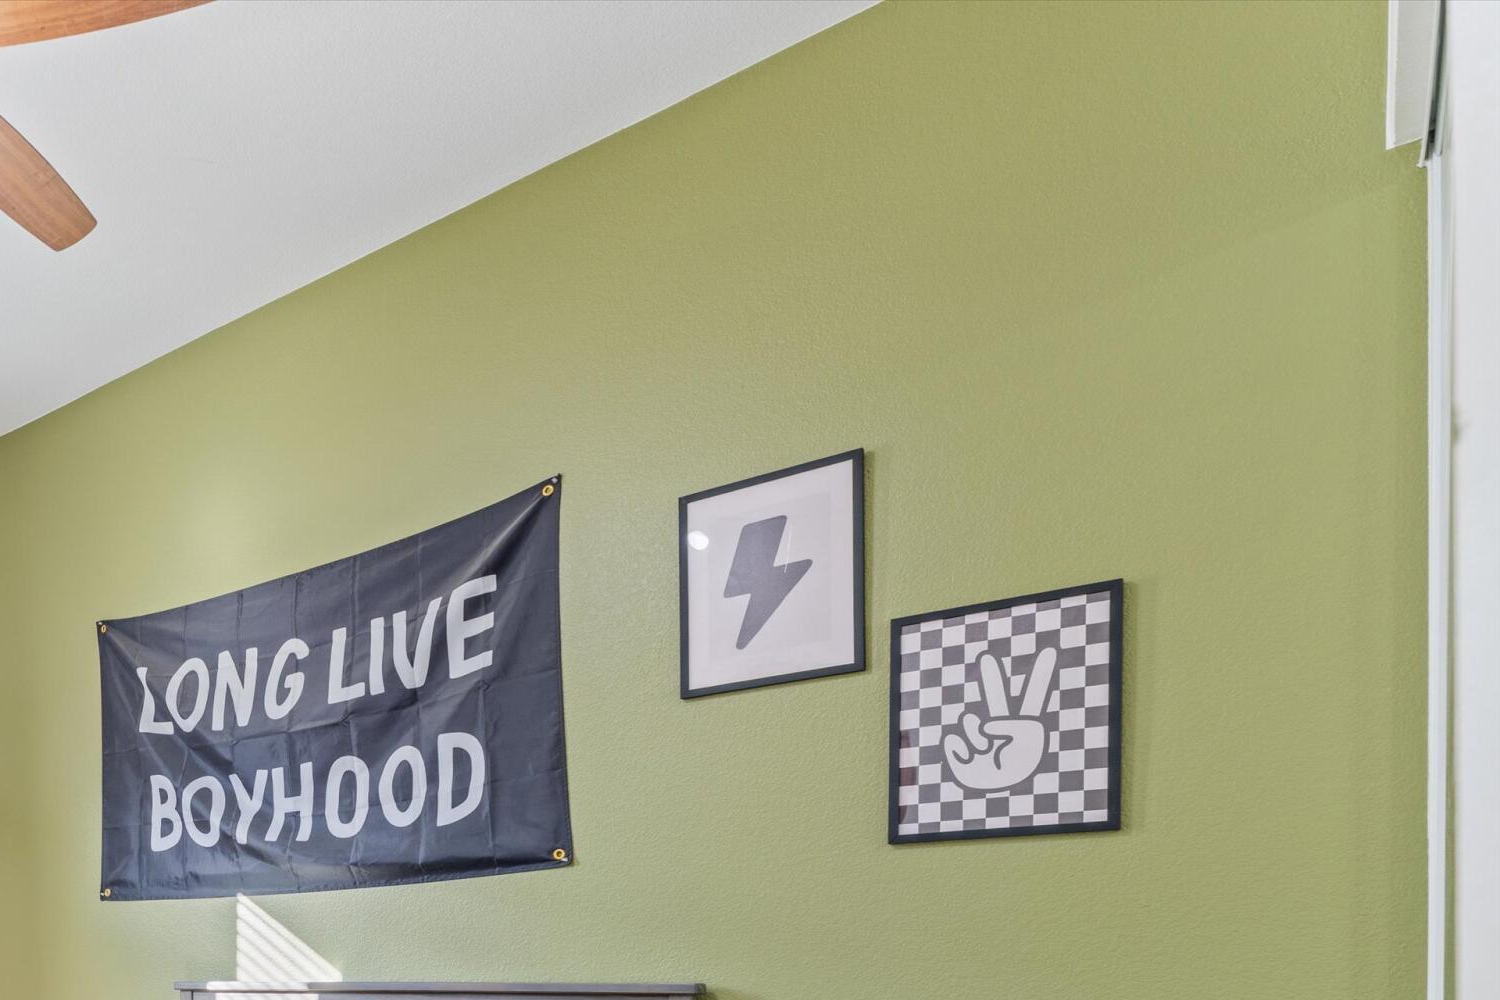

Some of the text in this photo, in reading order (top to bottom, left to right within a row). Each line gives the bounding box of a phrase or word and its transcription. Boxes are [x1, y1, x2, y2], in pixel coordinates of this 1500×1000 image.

[136, 574, 497, 735] LONG LIVE
[150, 732, 486, 852] BOYHOOD
